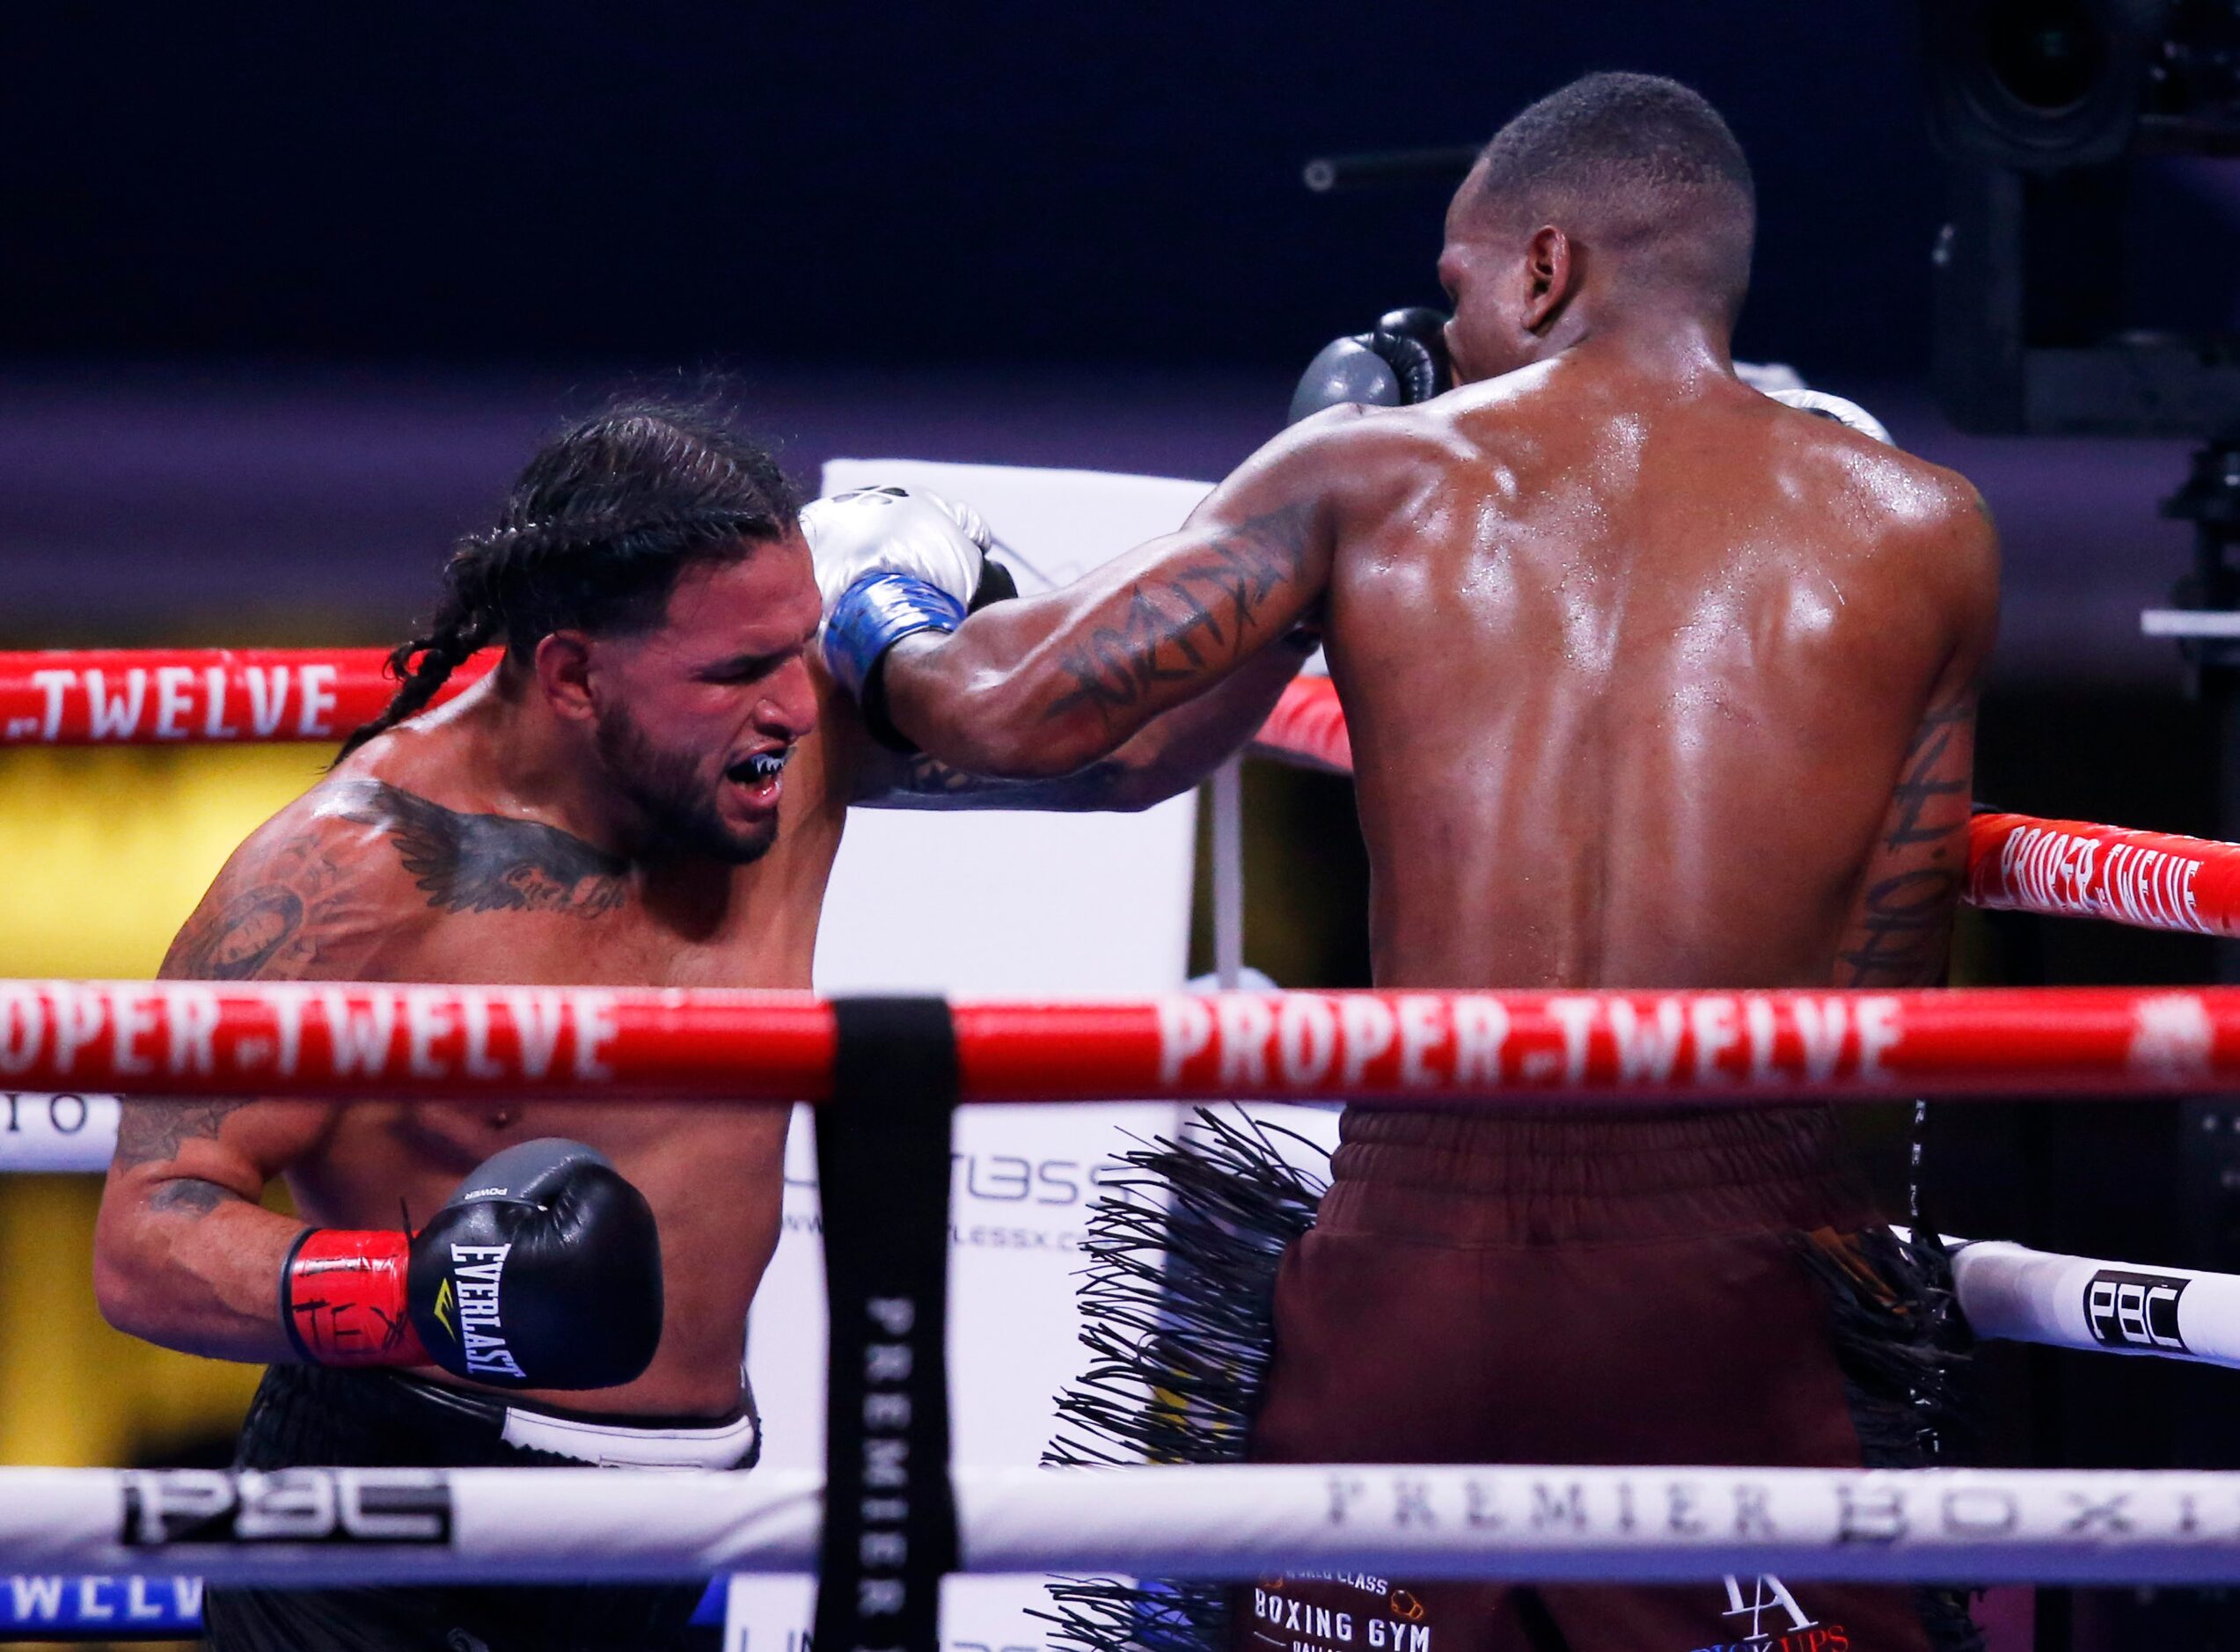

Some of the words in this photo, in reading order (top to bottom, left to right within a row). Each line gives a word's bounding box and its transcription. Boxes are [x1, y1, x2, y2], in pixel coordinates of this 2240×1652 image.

[33, 665, 336, 740] TWELVE
[2102, 843, 2213, 934] TWELVE
[265, 989, 616, 1081] TWELVE
[1154, 995, 1511, 1086] PROPER
[1547, 995, 1903, 1084] TWELVE
[464, 1188, 508, 1201] POWER
[450, 1242, 526, 1378] EVERLAST
[2089, 1281, 2183, 1349] PBC
[858, 1297, 915, 1619] PREMIER
[1327, 1480, 1777, 1540] PREMIER
[1835, 1483, 2240, 1544] BOXI
[1255, 1587, 1352, 1641] BOXING
[1367, 1618, 1430, 1652] GYM
